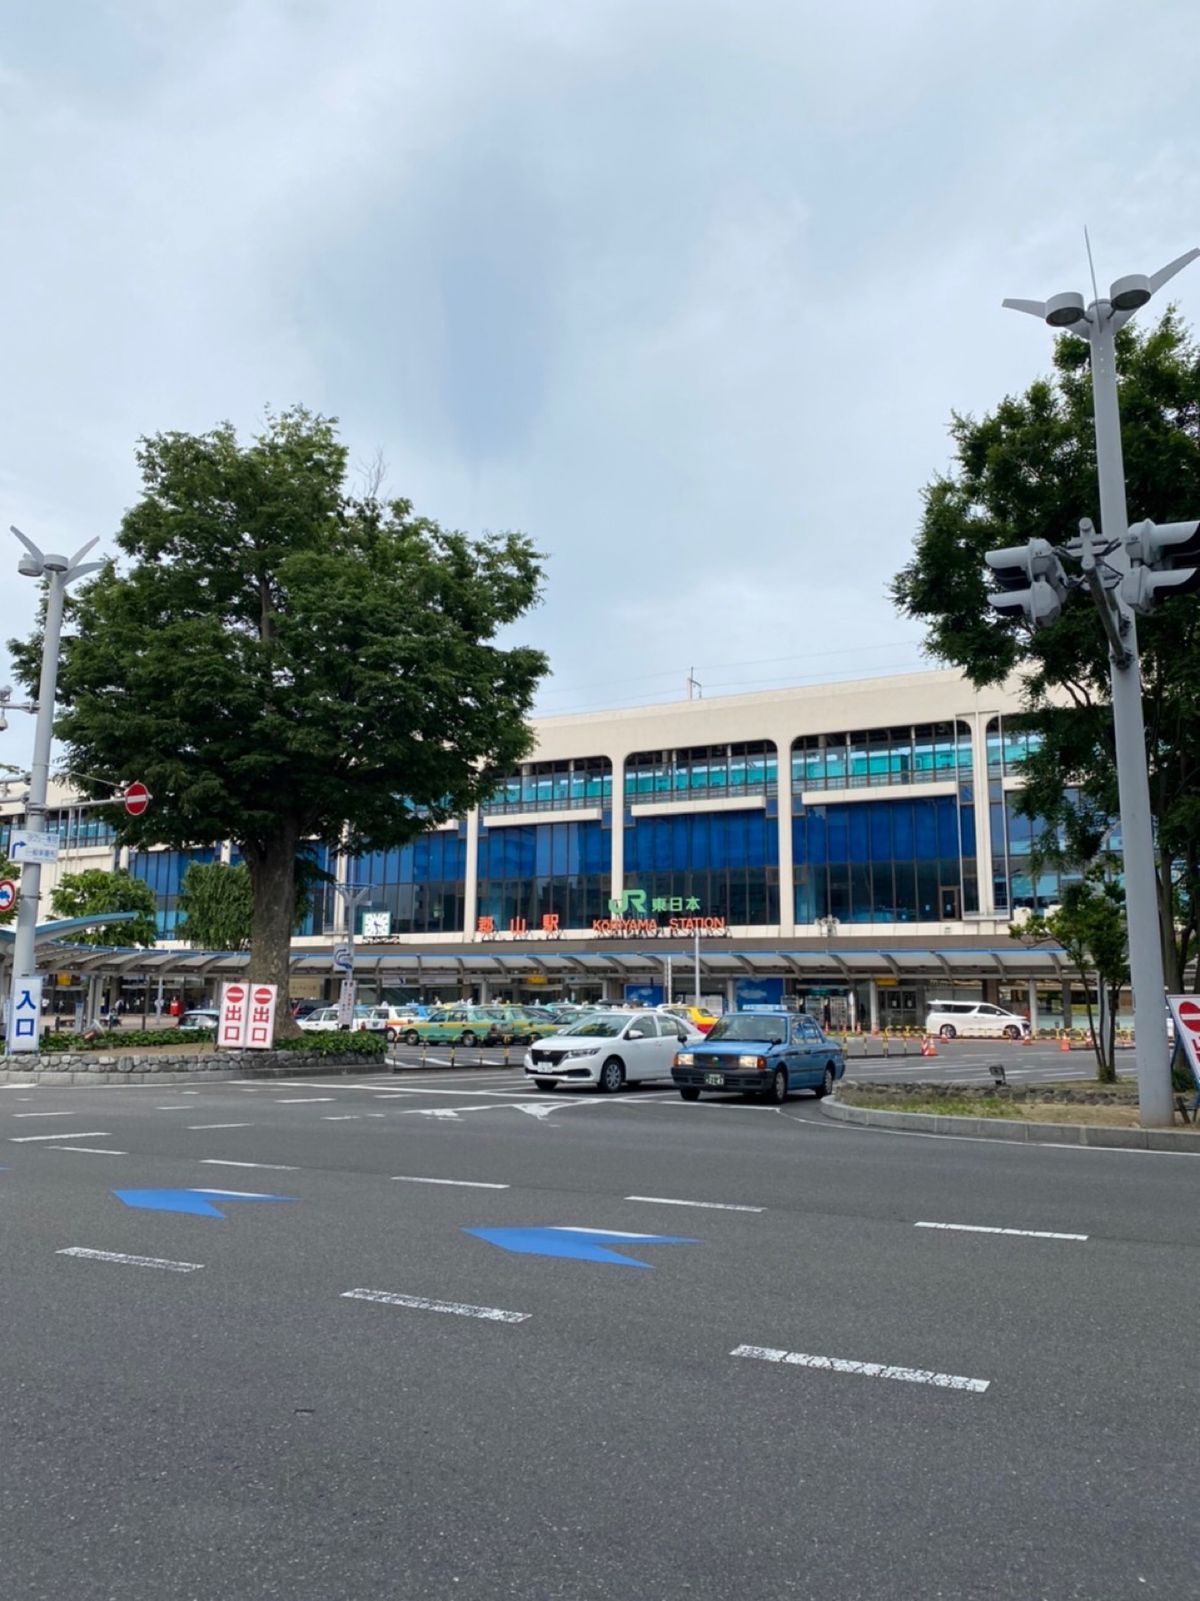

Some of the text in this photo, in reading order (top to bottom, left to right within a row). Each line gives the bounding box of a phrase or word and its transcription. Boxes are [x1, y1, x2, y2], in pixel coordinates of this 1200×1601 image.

[608, 889, 701, 914] JR 東日本
[669, 917, 725, 929] STATION
[16, 990, 36, 1037] 入口
[224, 1005, 242, 1041] 出口
[252, 1006, 270, 1043] 出口
